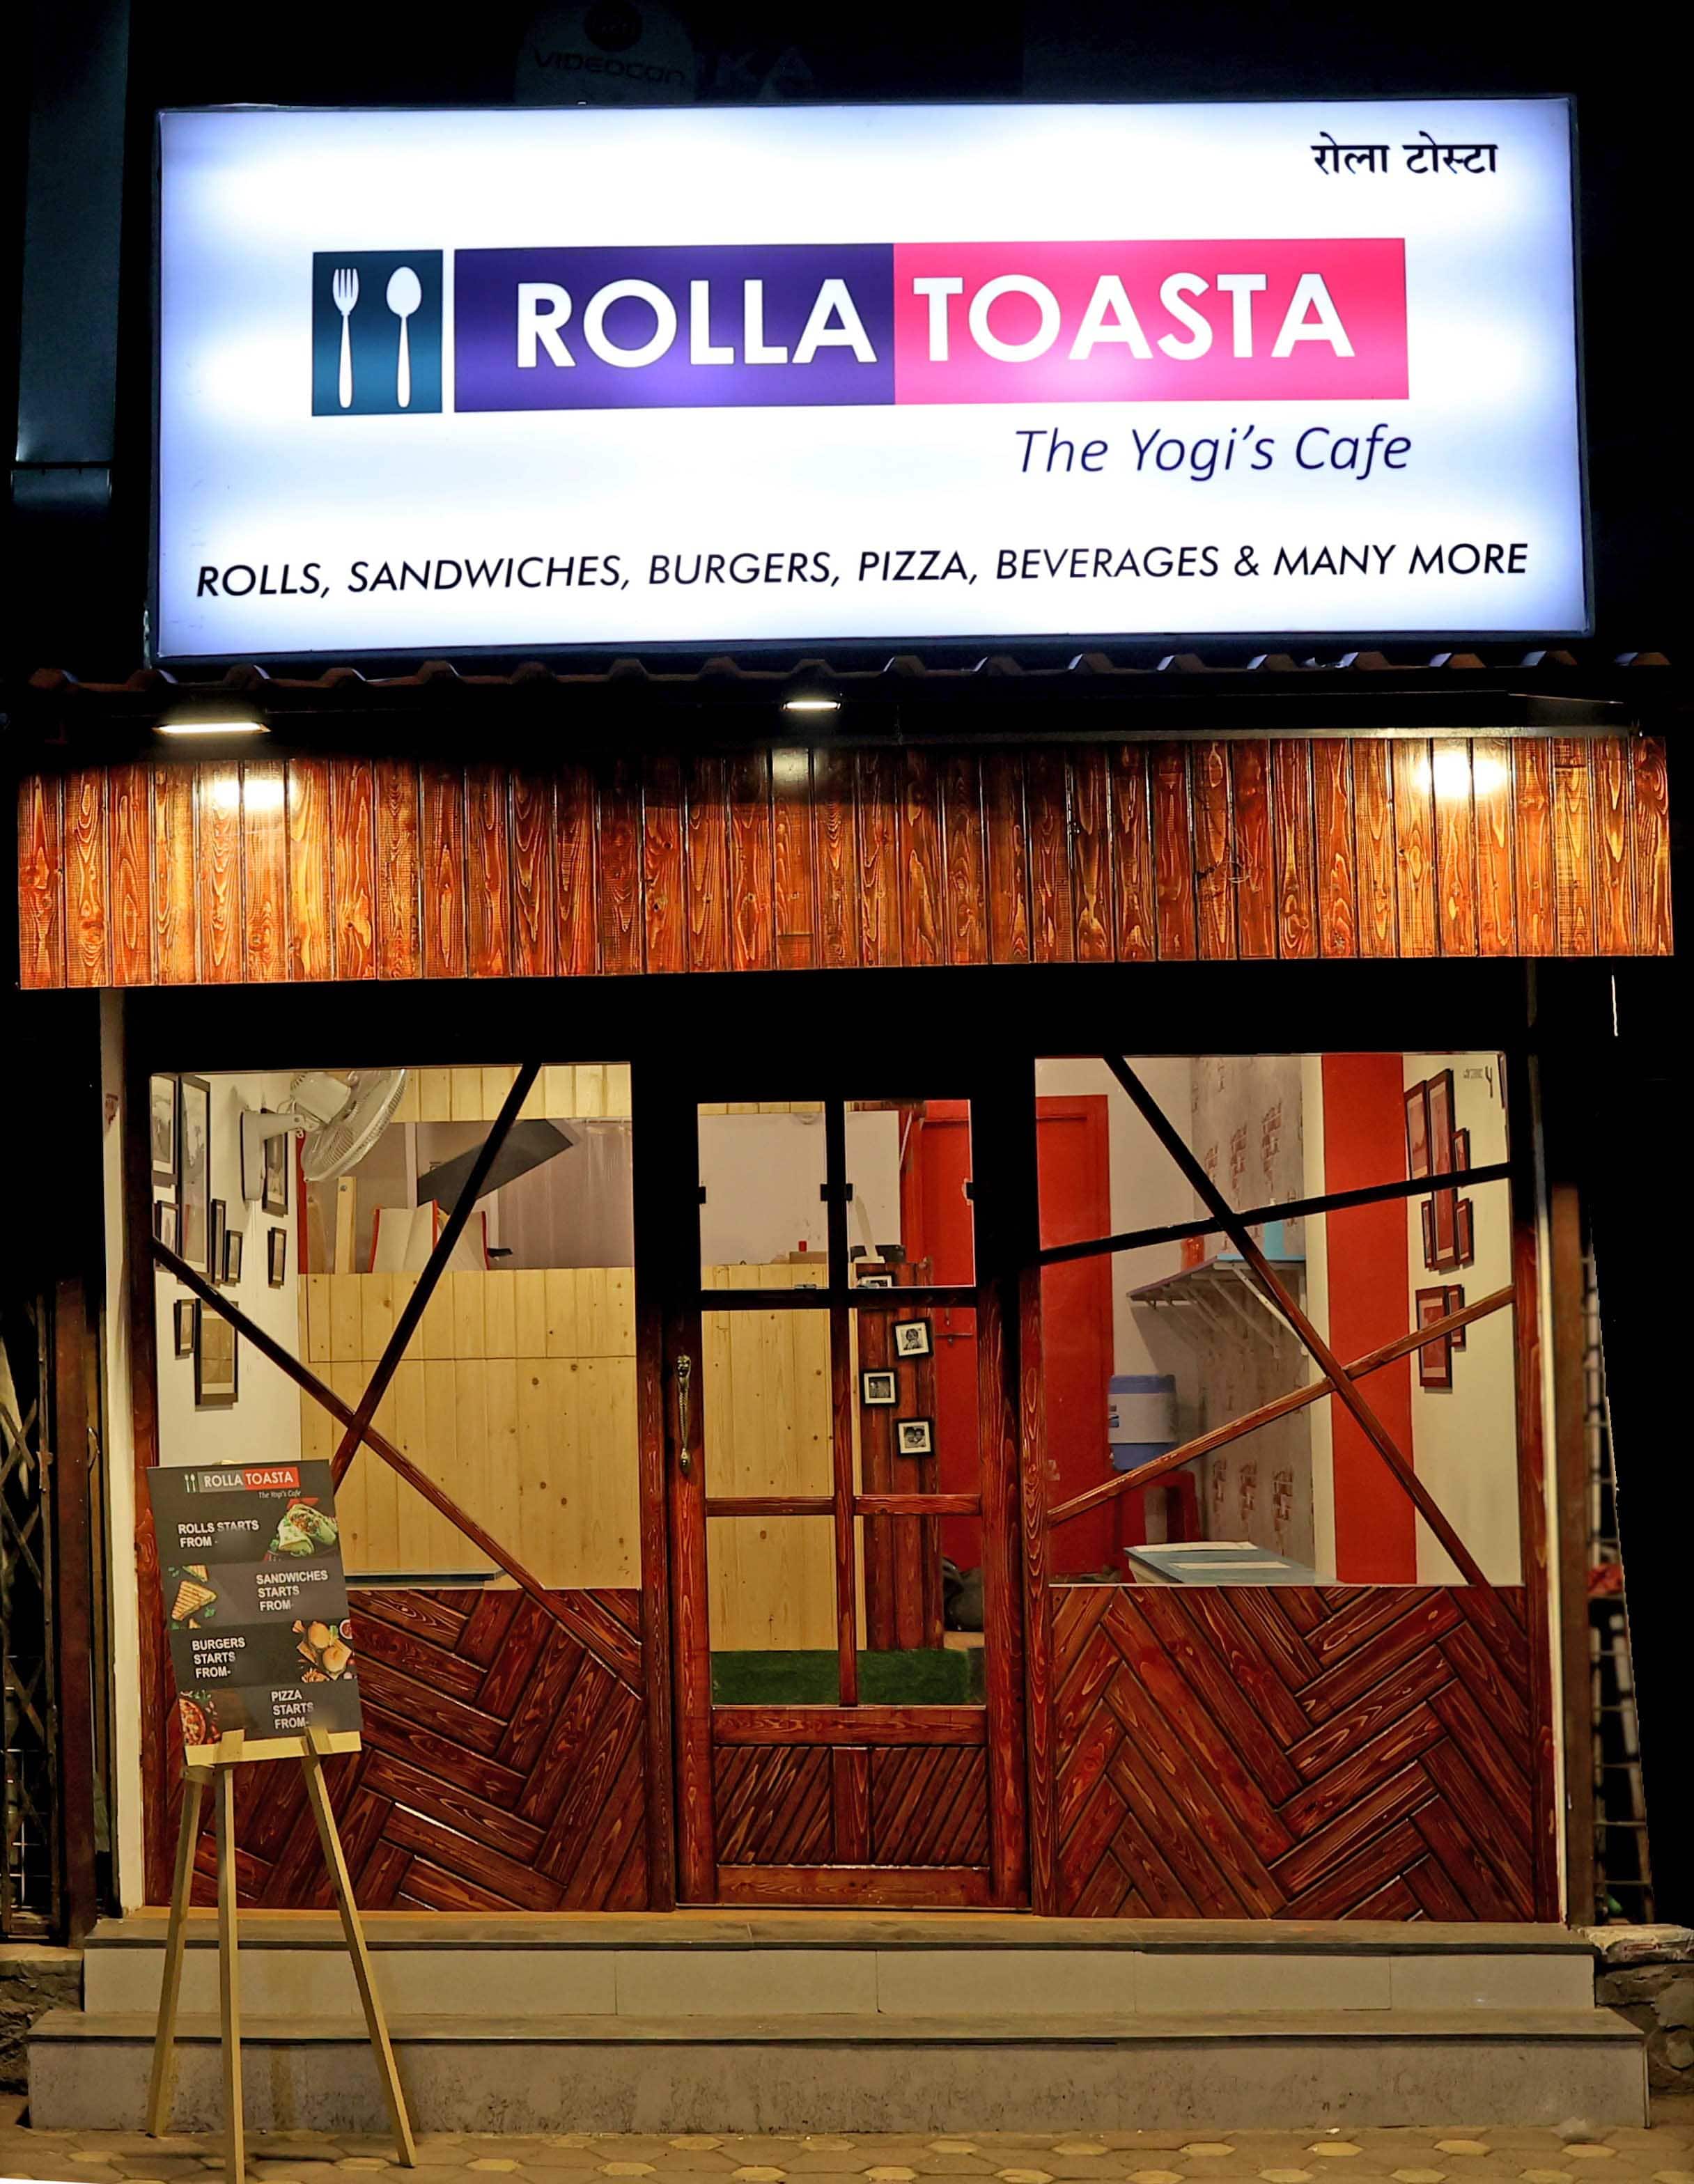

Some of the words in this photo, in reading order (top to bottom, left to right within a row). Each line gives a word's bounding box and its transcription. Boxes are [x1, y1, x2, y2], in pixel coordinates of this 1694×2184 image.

[1310, 131, 1390, 175] रोला
[1402, 130, 1498, 174] टोस्टा
[517, 279, 878, 368] ROLLA
[913, 272, 1355, 363] TOASTA
[1016, 427, 1109, 472] The
[1132, 424, 1275, 482] Yogi's
[1295, 423, 1412, 481] Cafe
[196, 563, 330, 598] ROLLS,
[348, 555, 630, 593] SANDWICHES,
[649, 552, 840, 587] BURGERS,
[859, 550, 977, 585] PIZZA,
[996, 545, 1219, 579] BEVERAGES
[1234, 545, 1259, 577] &
[1273, 545, 1396, 576] MANY
[1408, 543, 1528, 575] MORE
[204, 1474, 244, 1488] ROLLA
[245, 1471, 293, 1485] TOASTA
[178, 1522, 215, 1535] ROLLS
[217, 1520, 259, 1532] STARTS
[256, 1570, 329, 1584] SANDWICHES
[258, 1586, 300, 1598] STARTS
[192, 1637, 246, 1651] BURGERS
[194, 1651, 235, 1664] STARTS
[271, 1690, 302, 1702] PIZZA
[272, 1702, 313, 1715] STARTS
